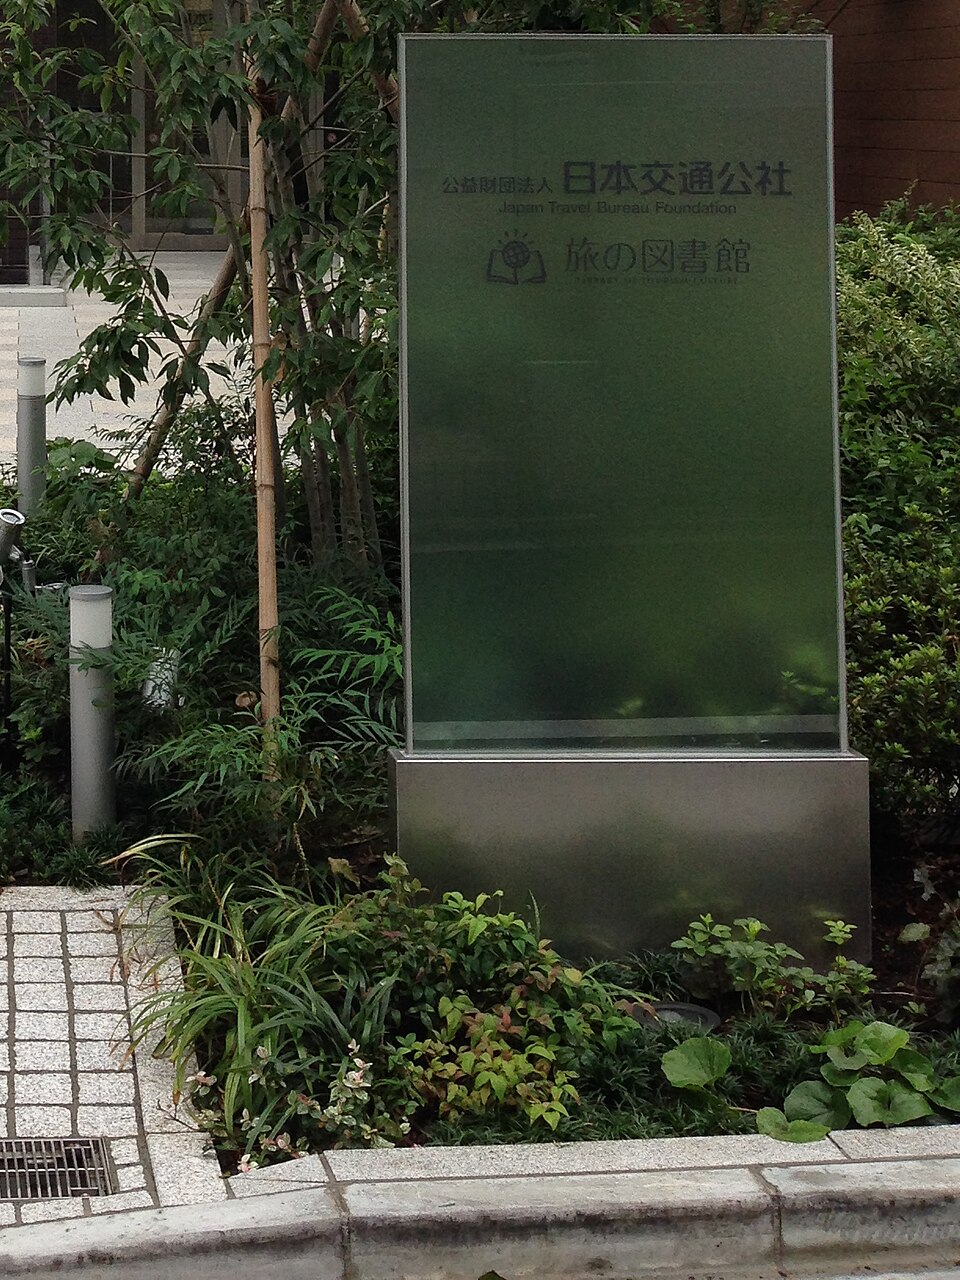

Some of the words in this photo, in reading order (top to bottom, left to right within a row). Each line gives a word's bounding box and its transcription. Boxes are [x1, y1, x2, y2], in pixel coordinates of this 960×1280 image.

[442, 176, 553, 194] 公益財団法人
[563, 160, 793, 196] 日本交通公社
[499, 201, 544, 216] Japan
[548, 201, 591, 214] Travel
[597, 201, 649, 214] Bureau
[655, 201, 737, 214] Foundation
[564, 236, 751, 274] 旅の図書館
